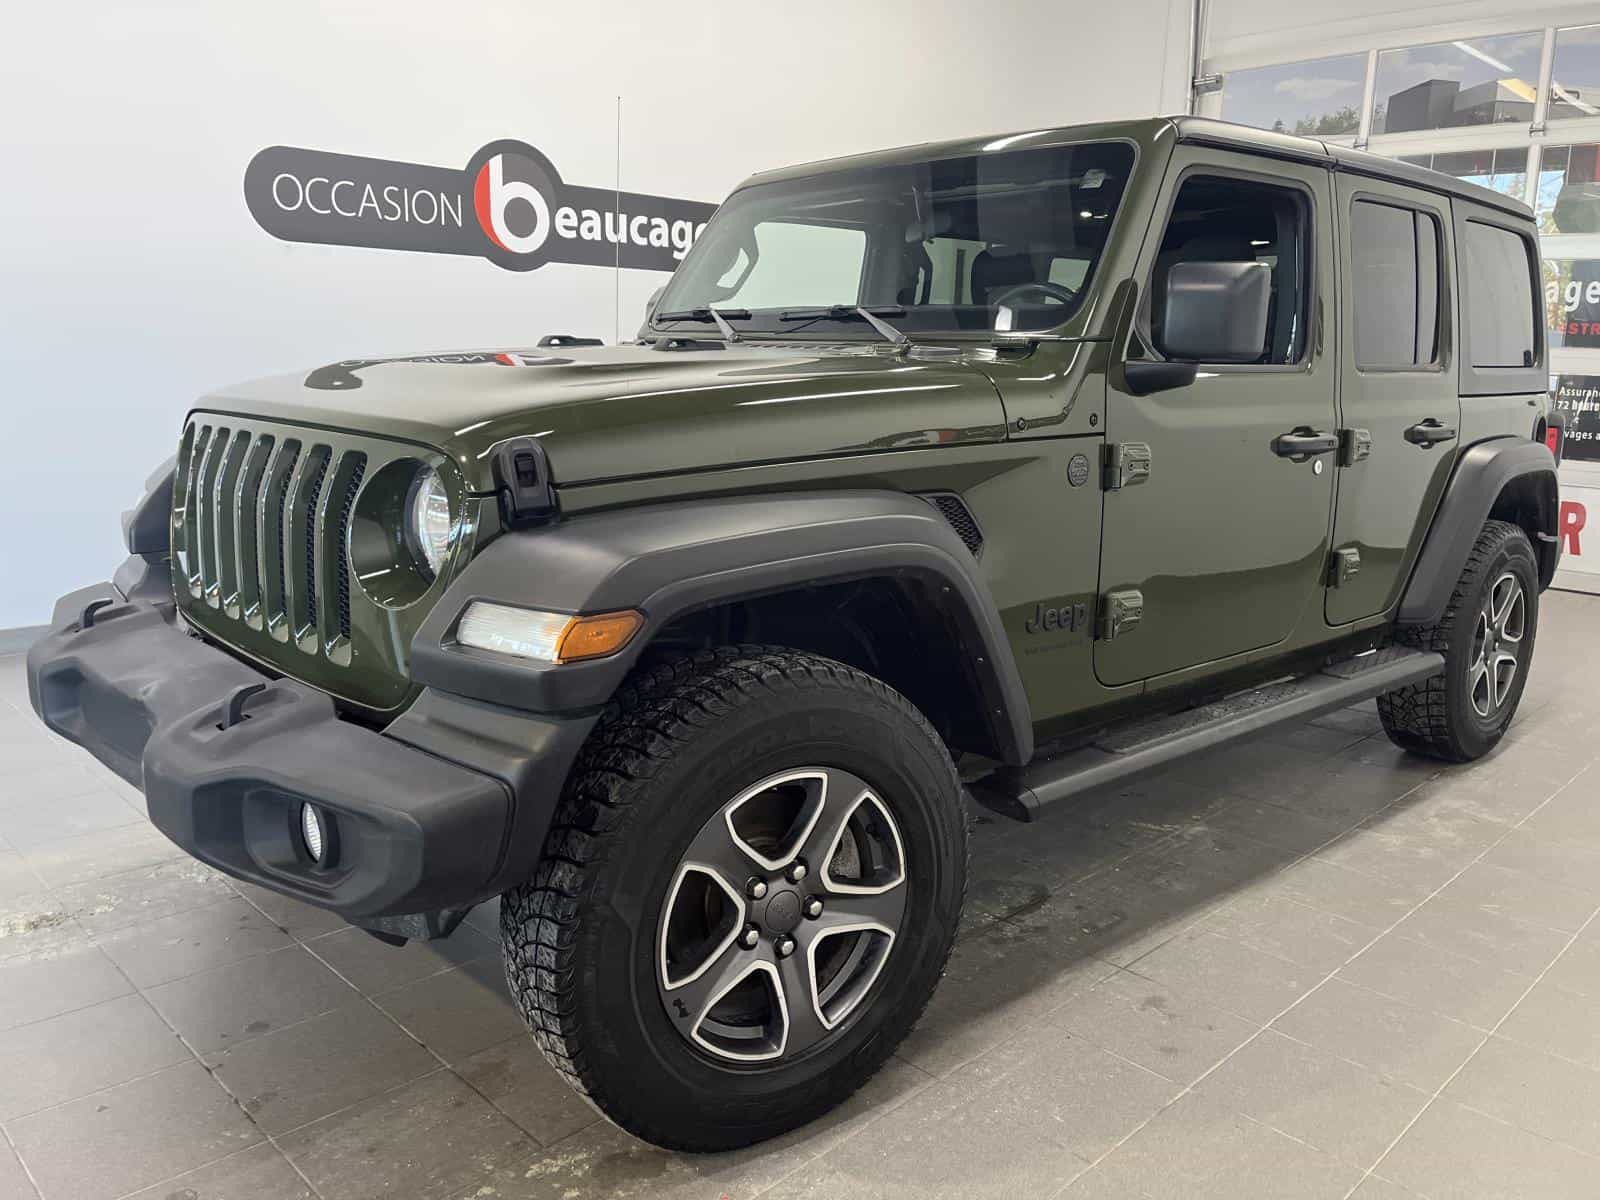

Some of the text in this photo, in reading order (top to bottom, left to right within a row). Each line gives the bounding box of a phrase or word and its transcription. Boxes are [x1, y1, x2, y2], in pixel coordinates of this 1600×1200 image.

[272, 173, 463, 228] OCCASION
[1557, 400, 1569, 410] 72
[1559, 385, 1600, 398] Assuran
[1560, 501, 1586, 556] R
[1025, 602, 1087, 634] Jeep
